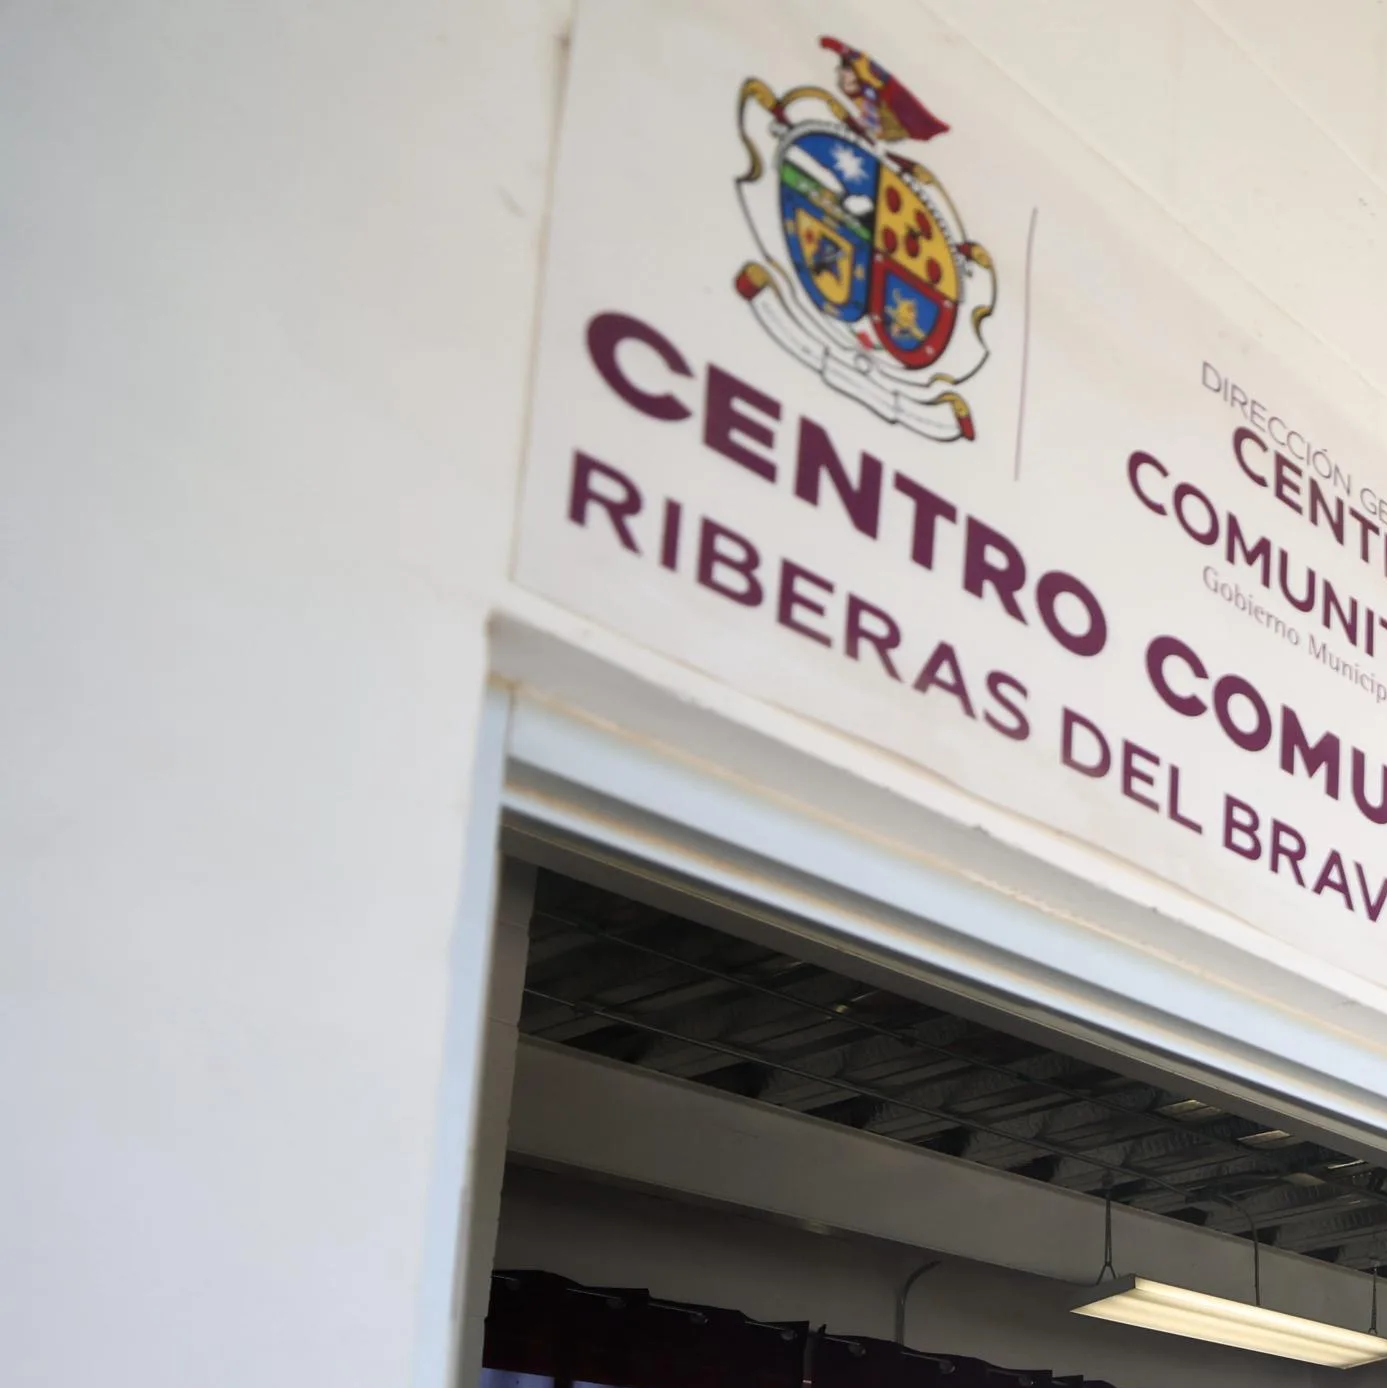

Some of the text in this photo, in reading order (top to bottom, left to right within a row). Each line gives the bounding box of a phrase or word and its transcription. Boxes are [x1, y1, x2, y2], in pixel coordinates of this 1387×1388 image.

[584, 309, 1109, 658] CENTRO
[1201, 361, 1352, 495] DIRECCIÓN
[568, 448, 1031, 742] RIBERAS
[1059, 707, 1203, 832] DEL
[1202, 564, 1299, 647] Gobierno
